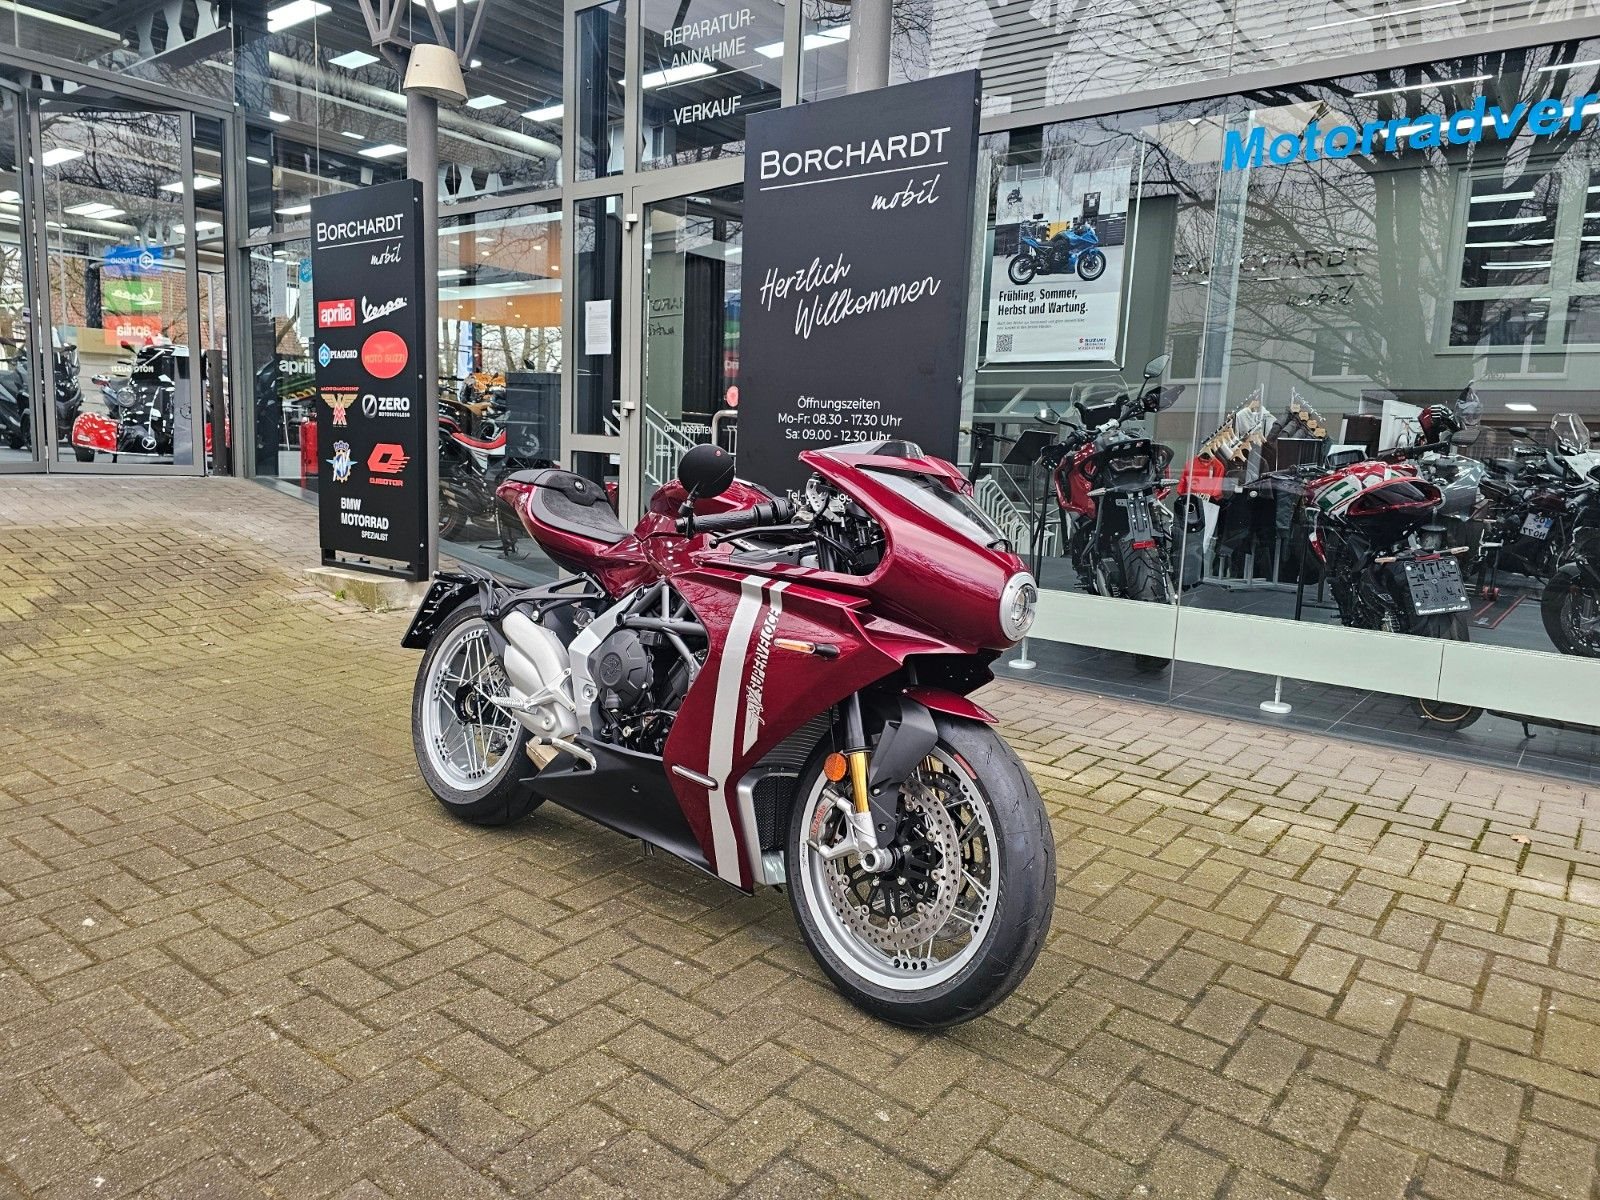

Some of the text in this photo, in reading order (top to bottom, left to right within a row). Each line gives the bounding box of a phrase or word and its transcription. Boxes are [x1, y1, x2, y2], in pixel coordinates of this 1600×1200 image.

[663, 8, 756, 48] REPARATUR-
[670, 36, 746, 70] ANNAHME
[673, 95, 742, 126] VERKAUF
[1223, 93, 1600, 172] Motorradver
[760, 127, 951, 180] BORCHARDT
[871, 173, 941, 210] mobil
[317, 213, 404, 243] BORCHARDT
[371, 243, 401, 266] mobil
[760, 253, 851, 312] Herzlich
[999, 288, 1078, 303] Frühling, Sommer,
[320, 303, 353, 326] aprilia
[361, 295, 407, 324] Vespa
[794, 276, 942, 340] Willkommen
[998, 302, 1089, 316] Herbst und Wartung.
[330, 349, 358, 360] PIAGGIO
[378, 397, 410, 412] ZERO
[797, 395, 881, 412] Öffnungszeiten
[778, 412, 811, 425] Mo-Fr:
[812, 413, 842, 426] 08.30
[851, 414, 878, 427] 17.30
[880, 415, 903, 427] Uhr
[785, 428, 801, 440] Sa:
[802, 429, 832, 441] 09.00
[840, 430, 868, 442] 12.30
[870, 431, 892, 442] Uhr
[341, 497, 362, 511] BMW
[341, 512, 390, 530] MOTORRAD
[361, 530, 389, 541] SPEZIALIST
